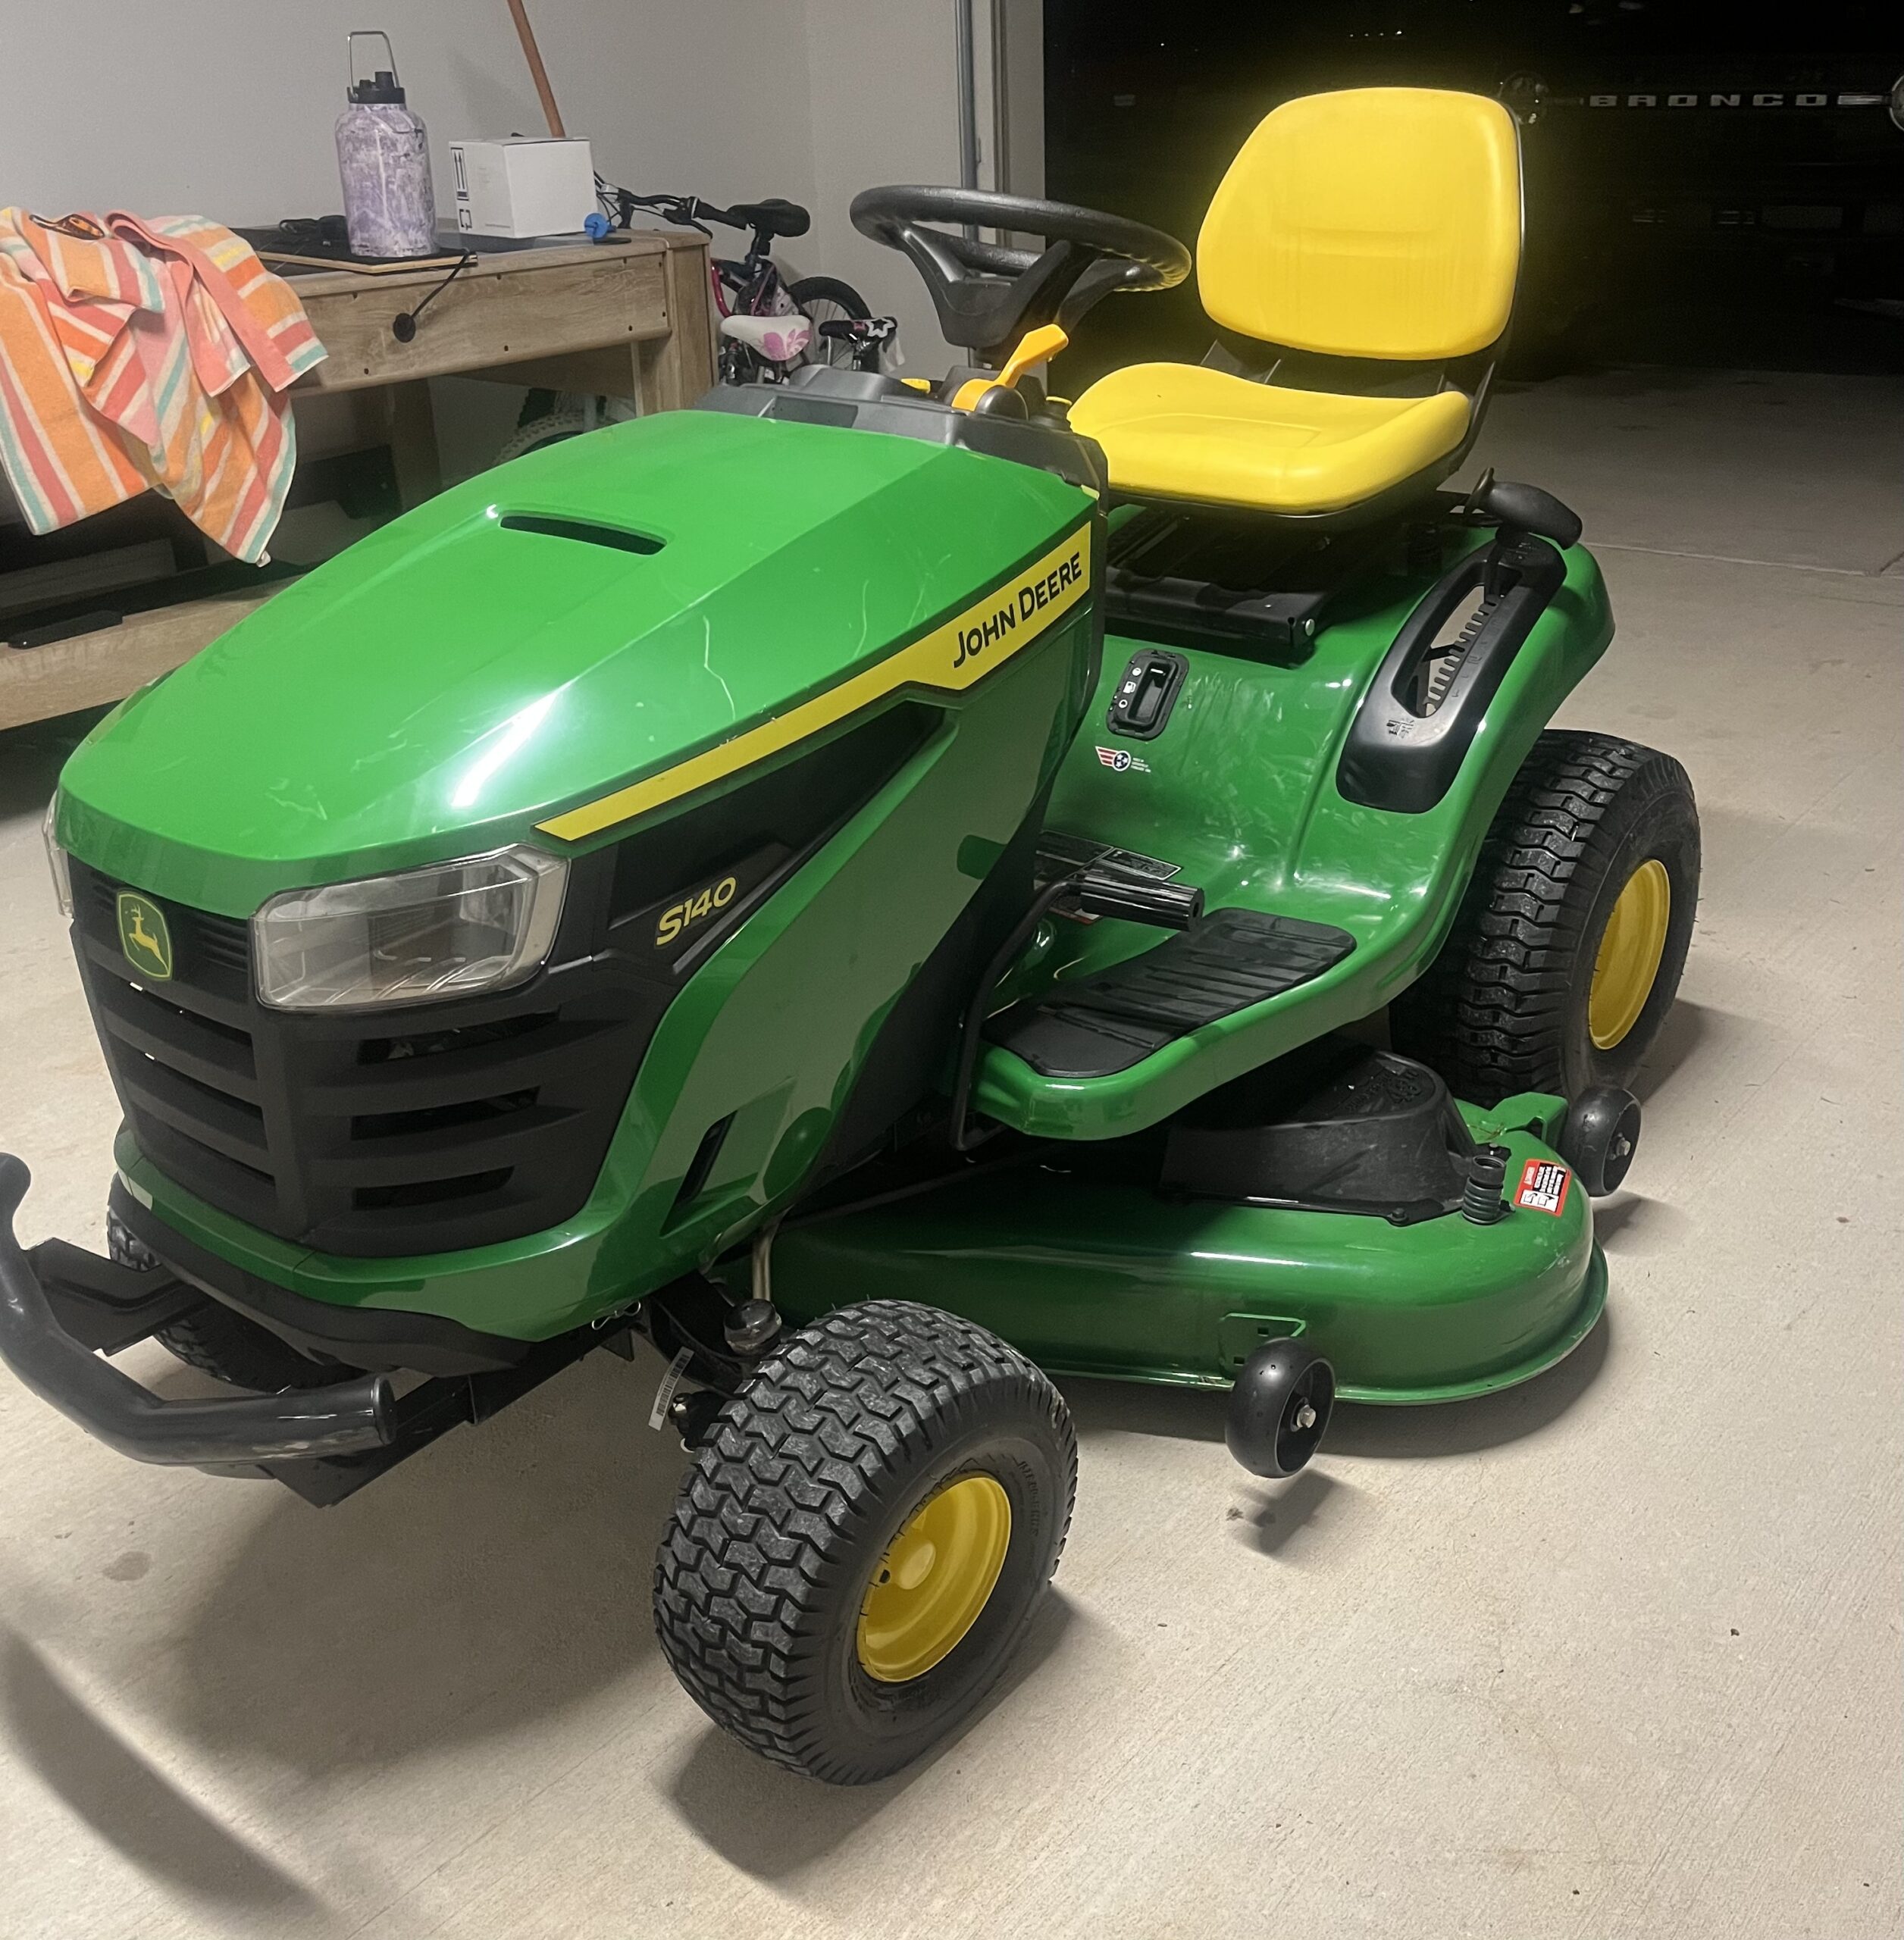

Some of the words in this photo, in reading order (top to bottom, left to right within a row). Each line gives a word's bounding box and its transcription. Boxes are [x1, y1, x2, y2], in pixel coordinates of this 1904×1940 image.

[1589, 94, 1828, 108] BRONCO
[953, 603, 1016, 668] JOHN
[1018, 551, 1082, 622] DEERE
[656, 877, 737, 947] S140
